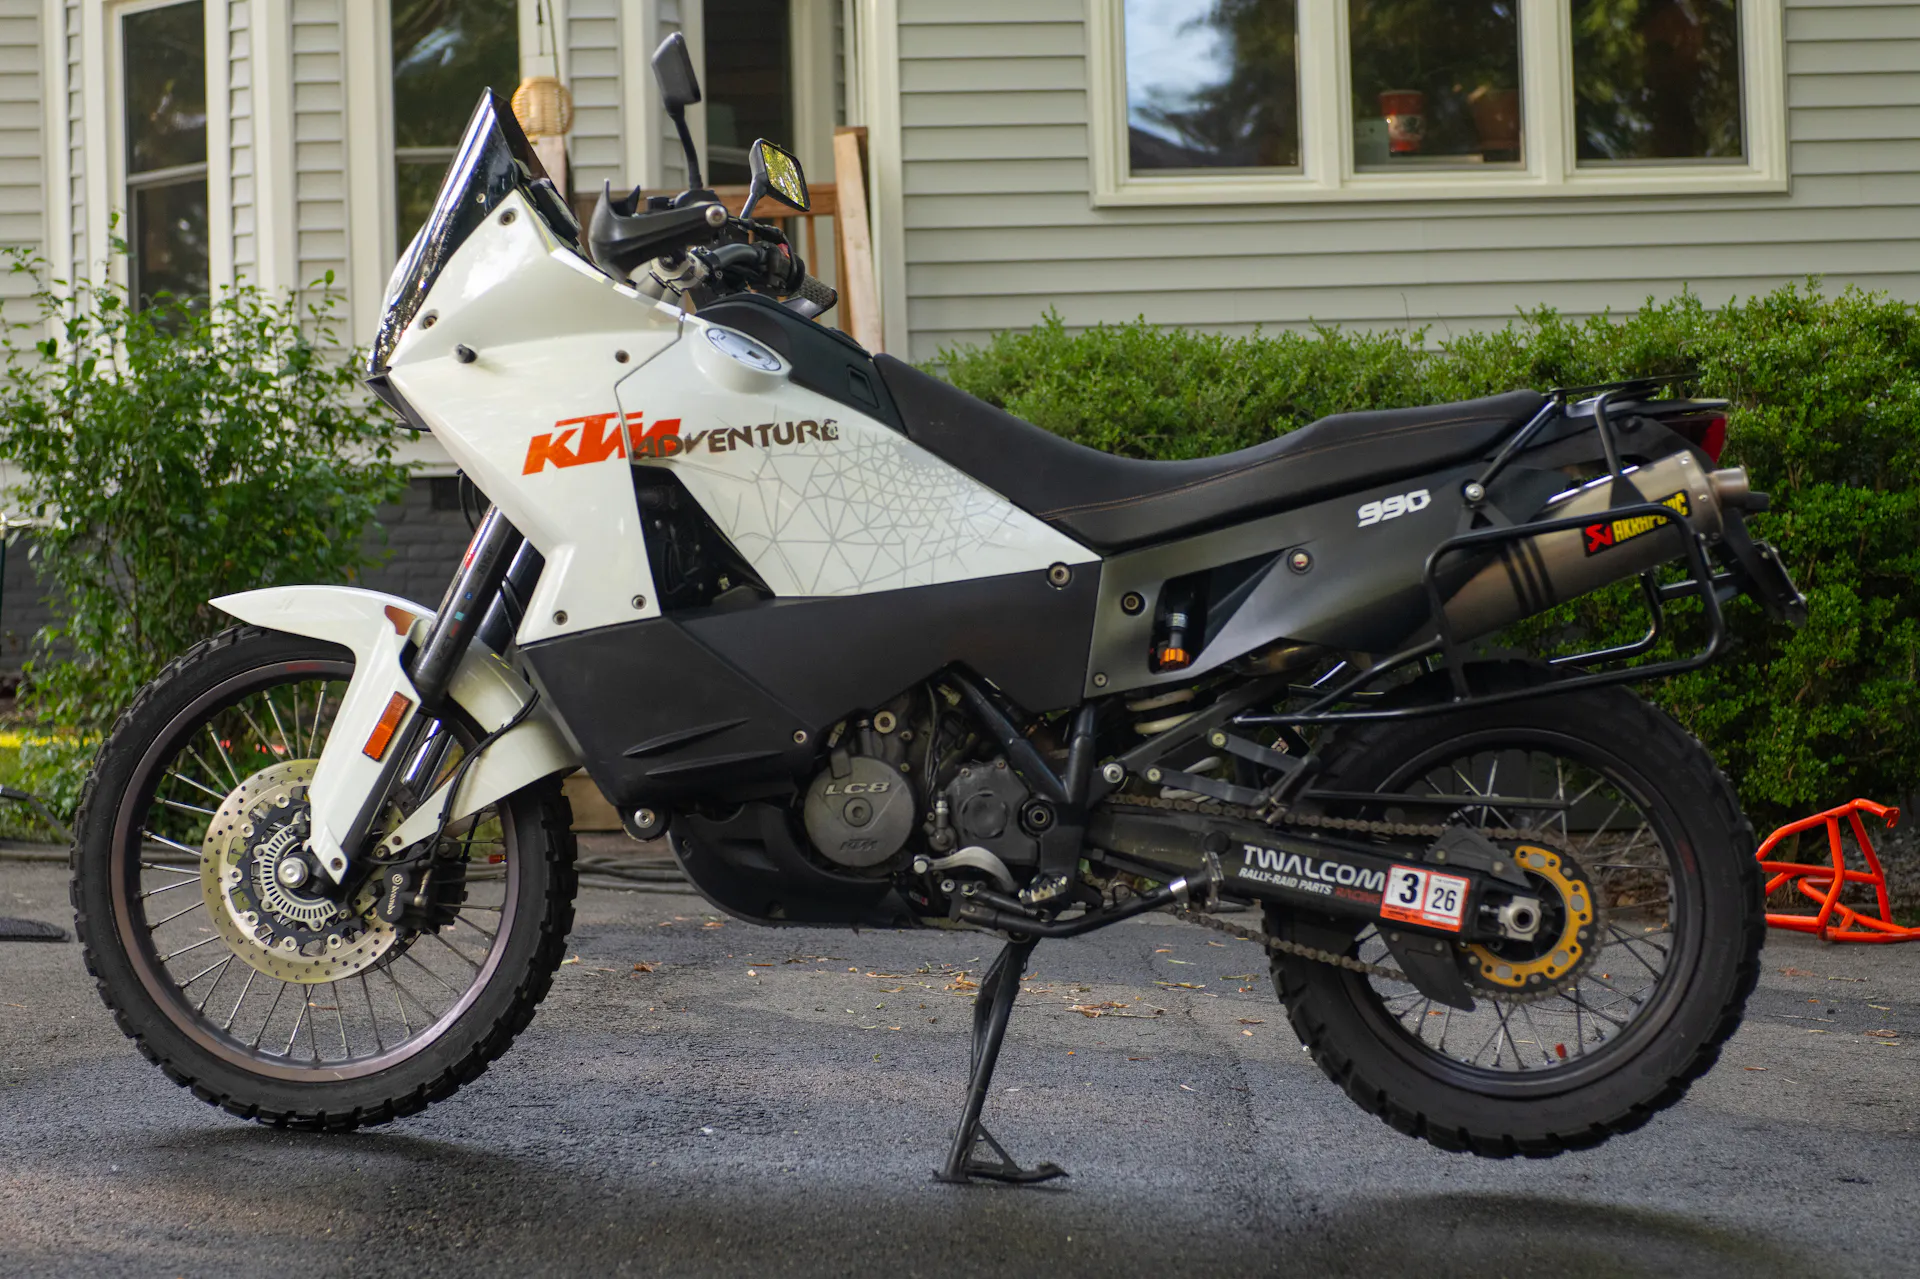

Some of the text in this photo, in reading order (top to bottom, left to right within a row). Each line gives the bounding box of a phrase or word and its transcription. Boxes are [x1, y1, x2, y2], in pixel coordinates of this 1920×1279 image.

[522, 411, 681, 476] KTM
[634, 418, 839, 458] ADVENTURE
[1358, 489, 1431, 527] 990
[824, 782, 890, 796] LC8
[1239, 867, 1298, 888] RALLY-RAID
[1298, 880, 1333, 895] PARTS
[1243, 844, 1386, 892] TWALCOM
[1399, 873, 1419, 904] 3
[1432, 887, 1457, 912] 26
